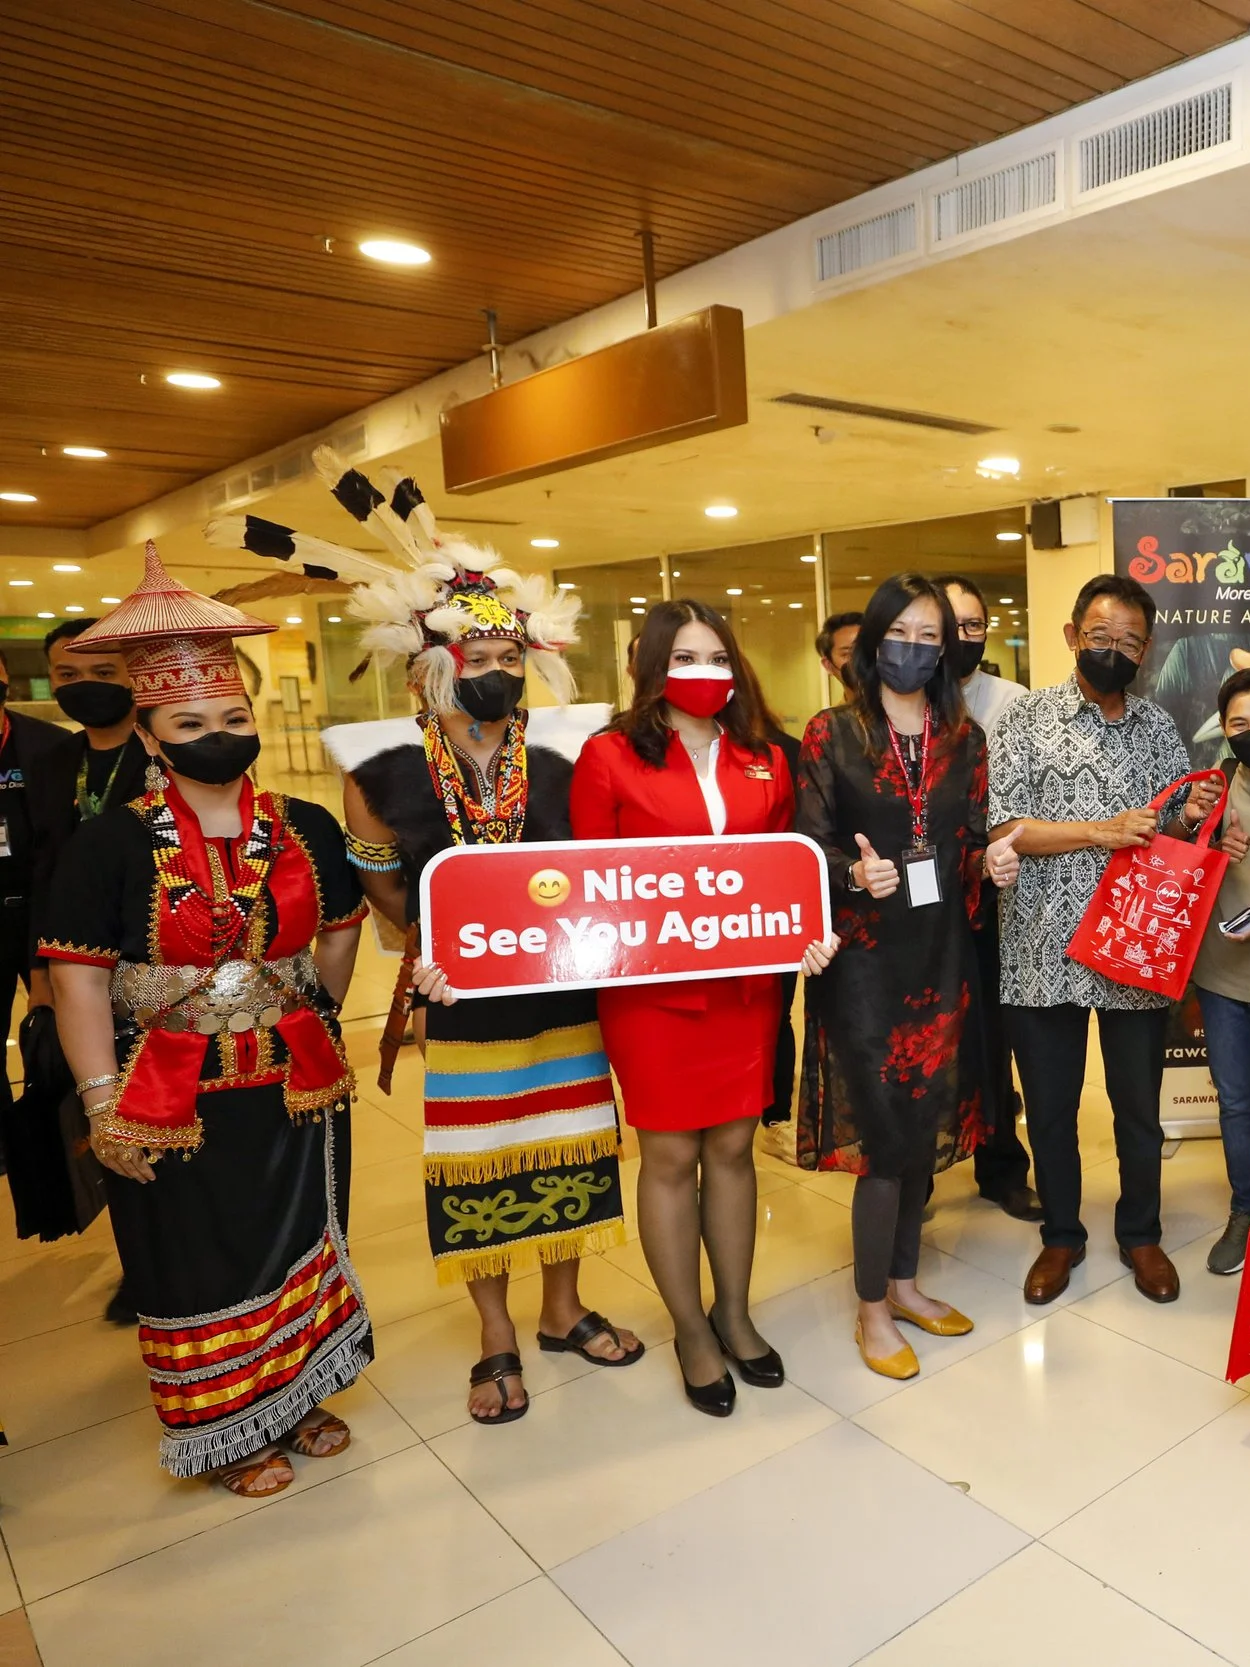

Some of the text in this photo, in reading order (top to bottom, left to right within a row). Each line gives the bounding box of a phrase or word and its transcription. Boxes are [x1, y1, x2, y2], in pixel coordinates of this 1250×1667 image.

[1155, 610, 1232, 624] NATURE
[583, 865, 743, 903] Nice to
[458, 904, 802, 958] See You Again!
